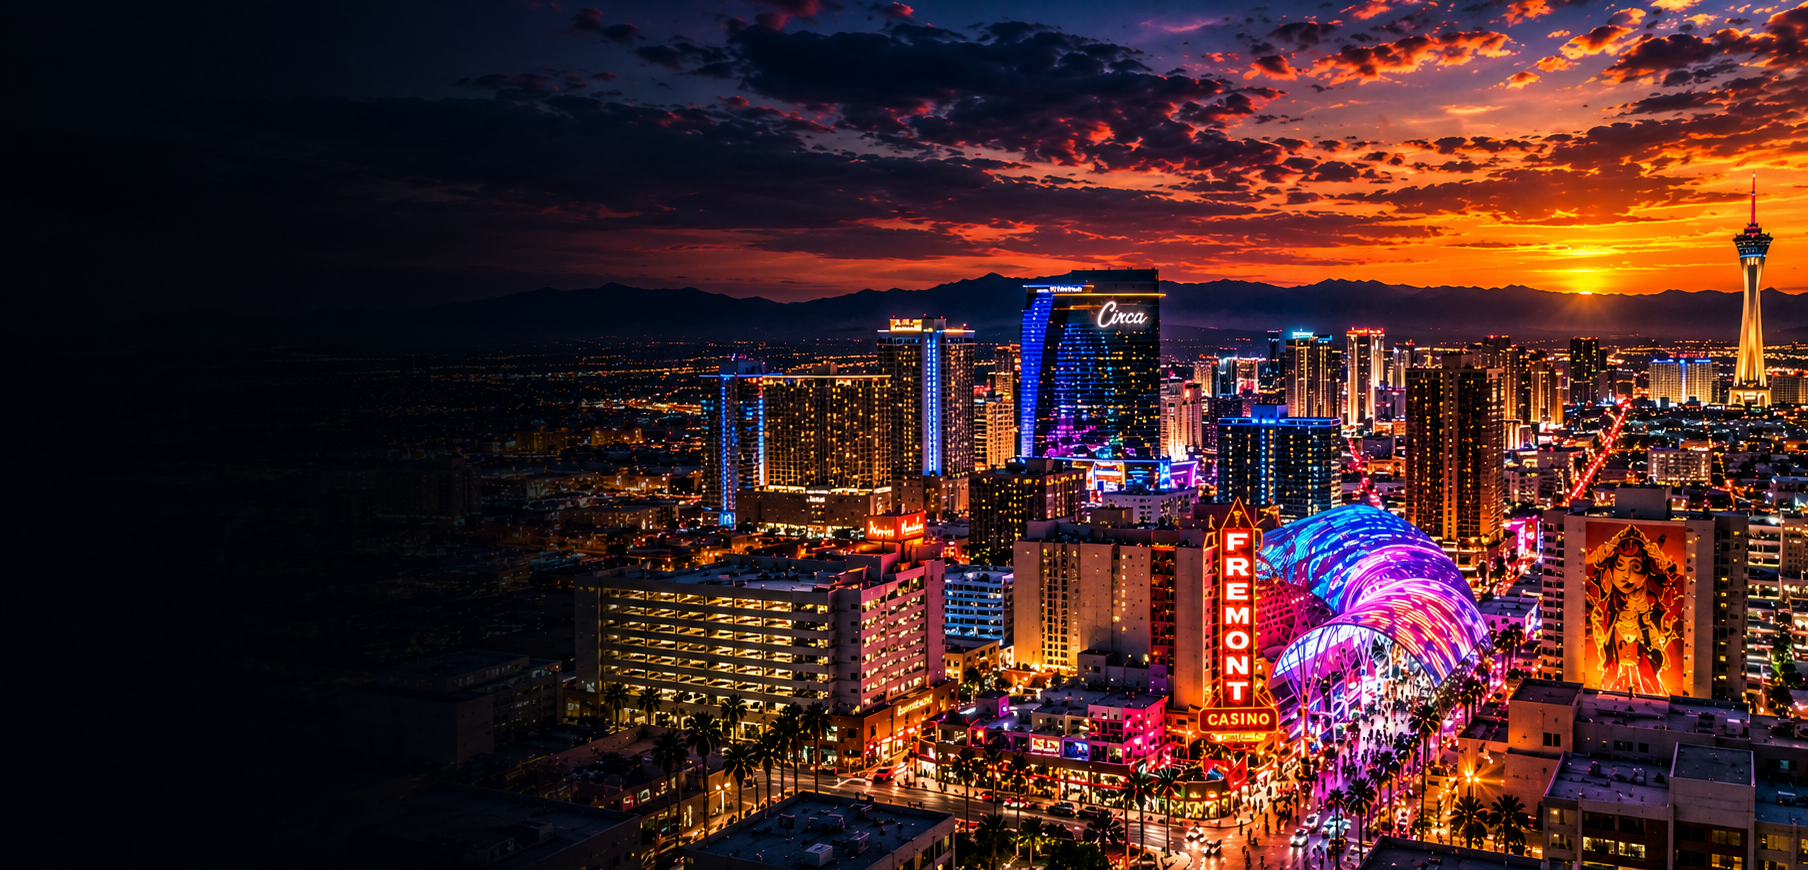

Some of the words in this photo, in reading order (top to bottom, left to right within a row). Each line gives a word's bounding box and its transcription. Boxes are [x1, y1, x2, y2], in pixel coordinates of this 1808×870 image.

[1098, 301, 1148, 328] Circa
[1226, 533, 1249, 700] FREMONT
[1208, 713, 1270, 726] CASINO
